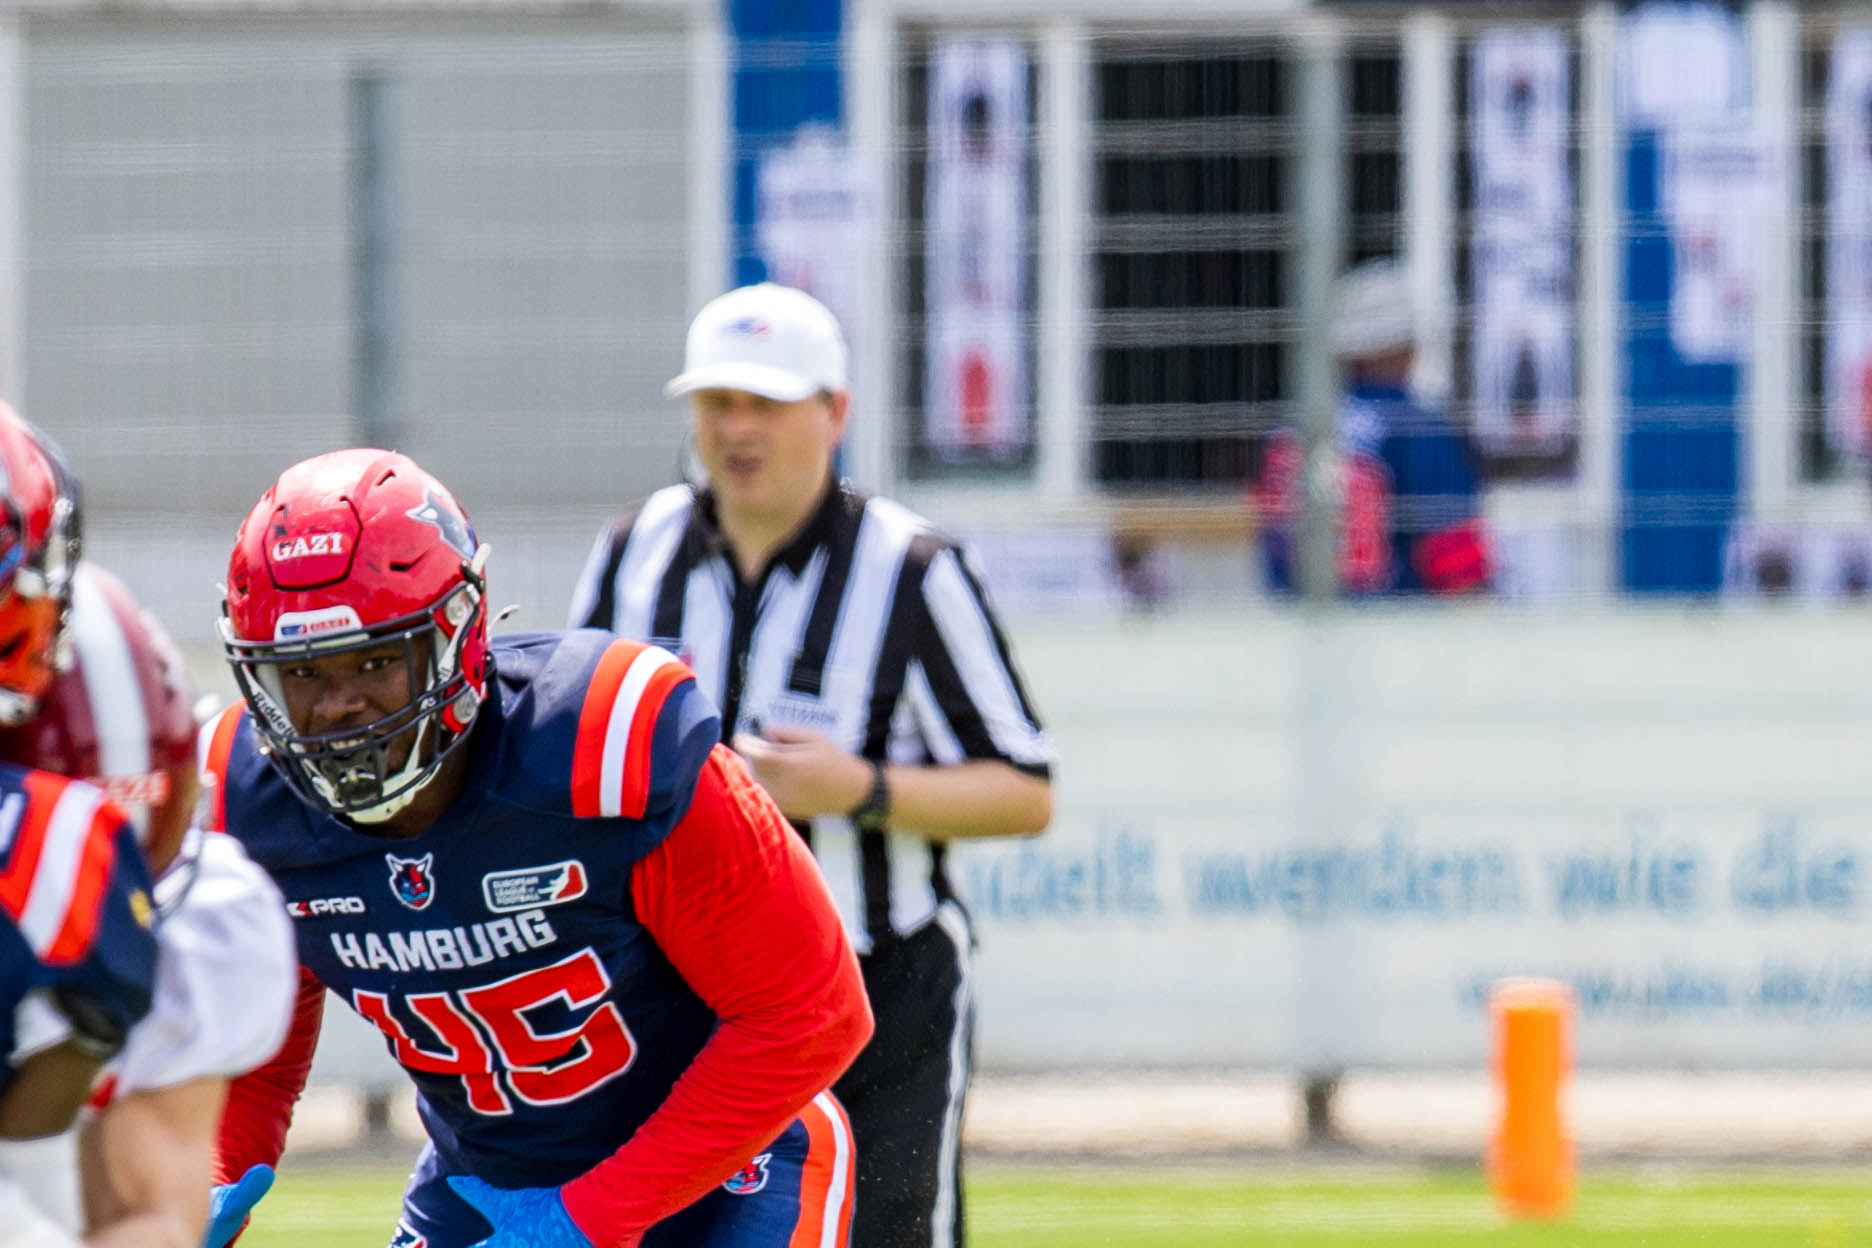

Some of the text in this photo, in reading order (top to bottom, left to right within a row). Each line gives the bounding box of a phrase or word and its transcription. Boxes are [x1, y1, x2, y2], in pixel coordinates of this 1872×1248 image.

[272, 532, 343, 561] GAZI
[330, 909, 557, 973] HAMBURG
[352, 946, 638, 1116] 45
